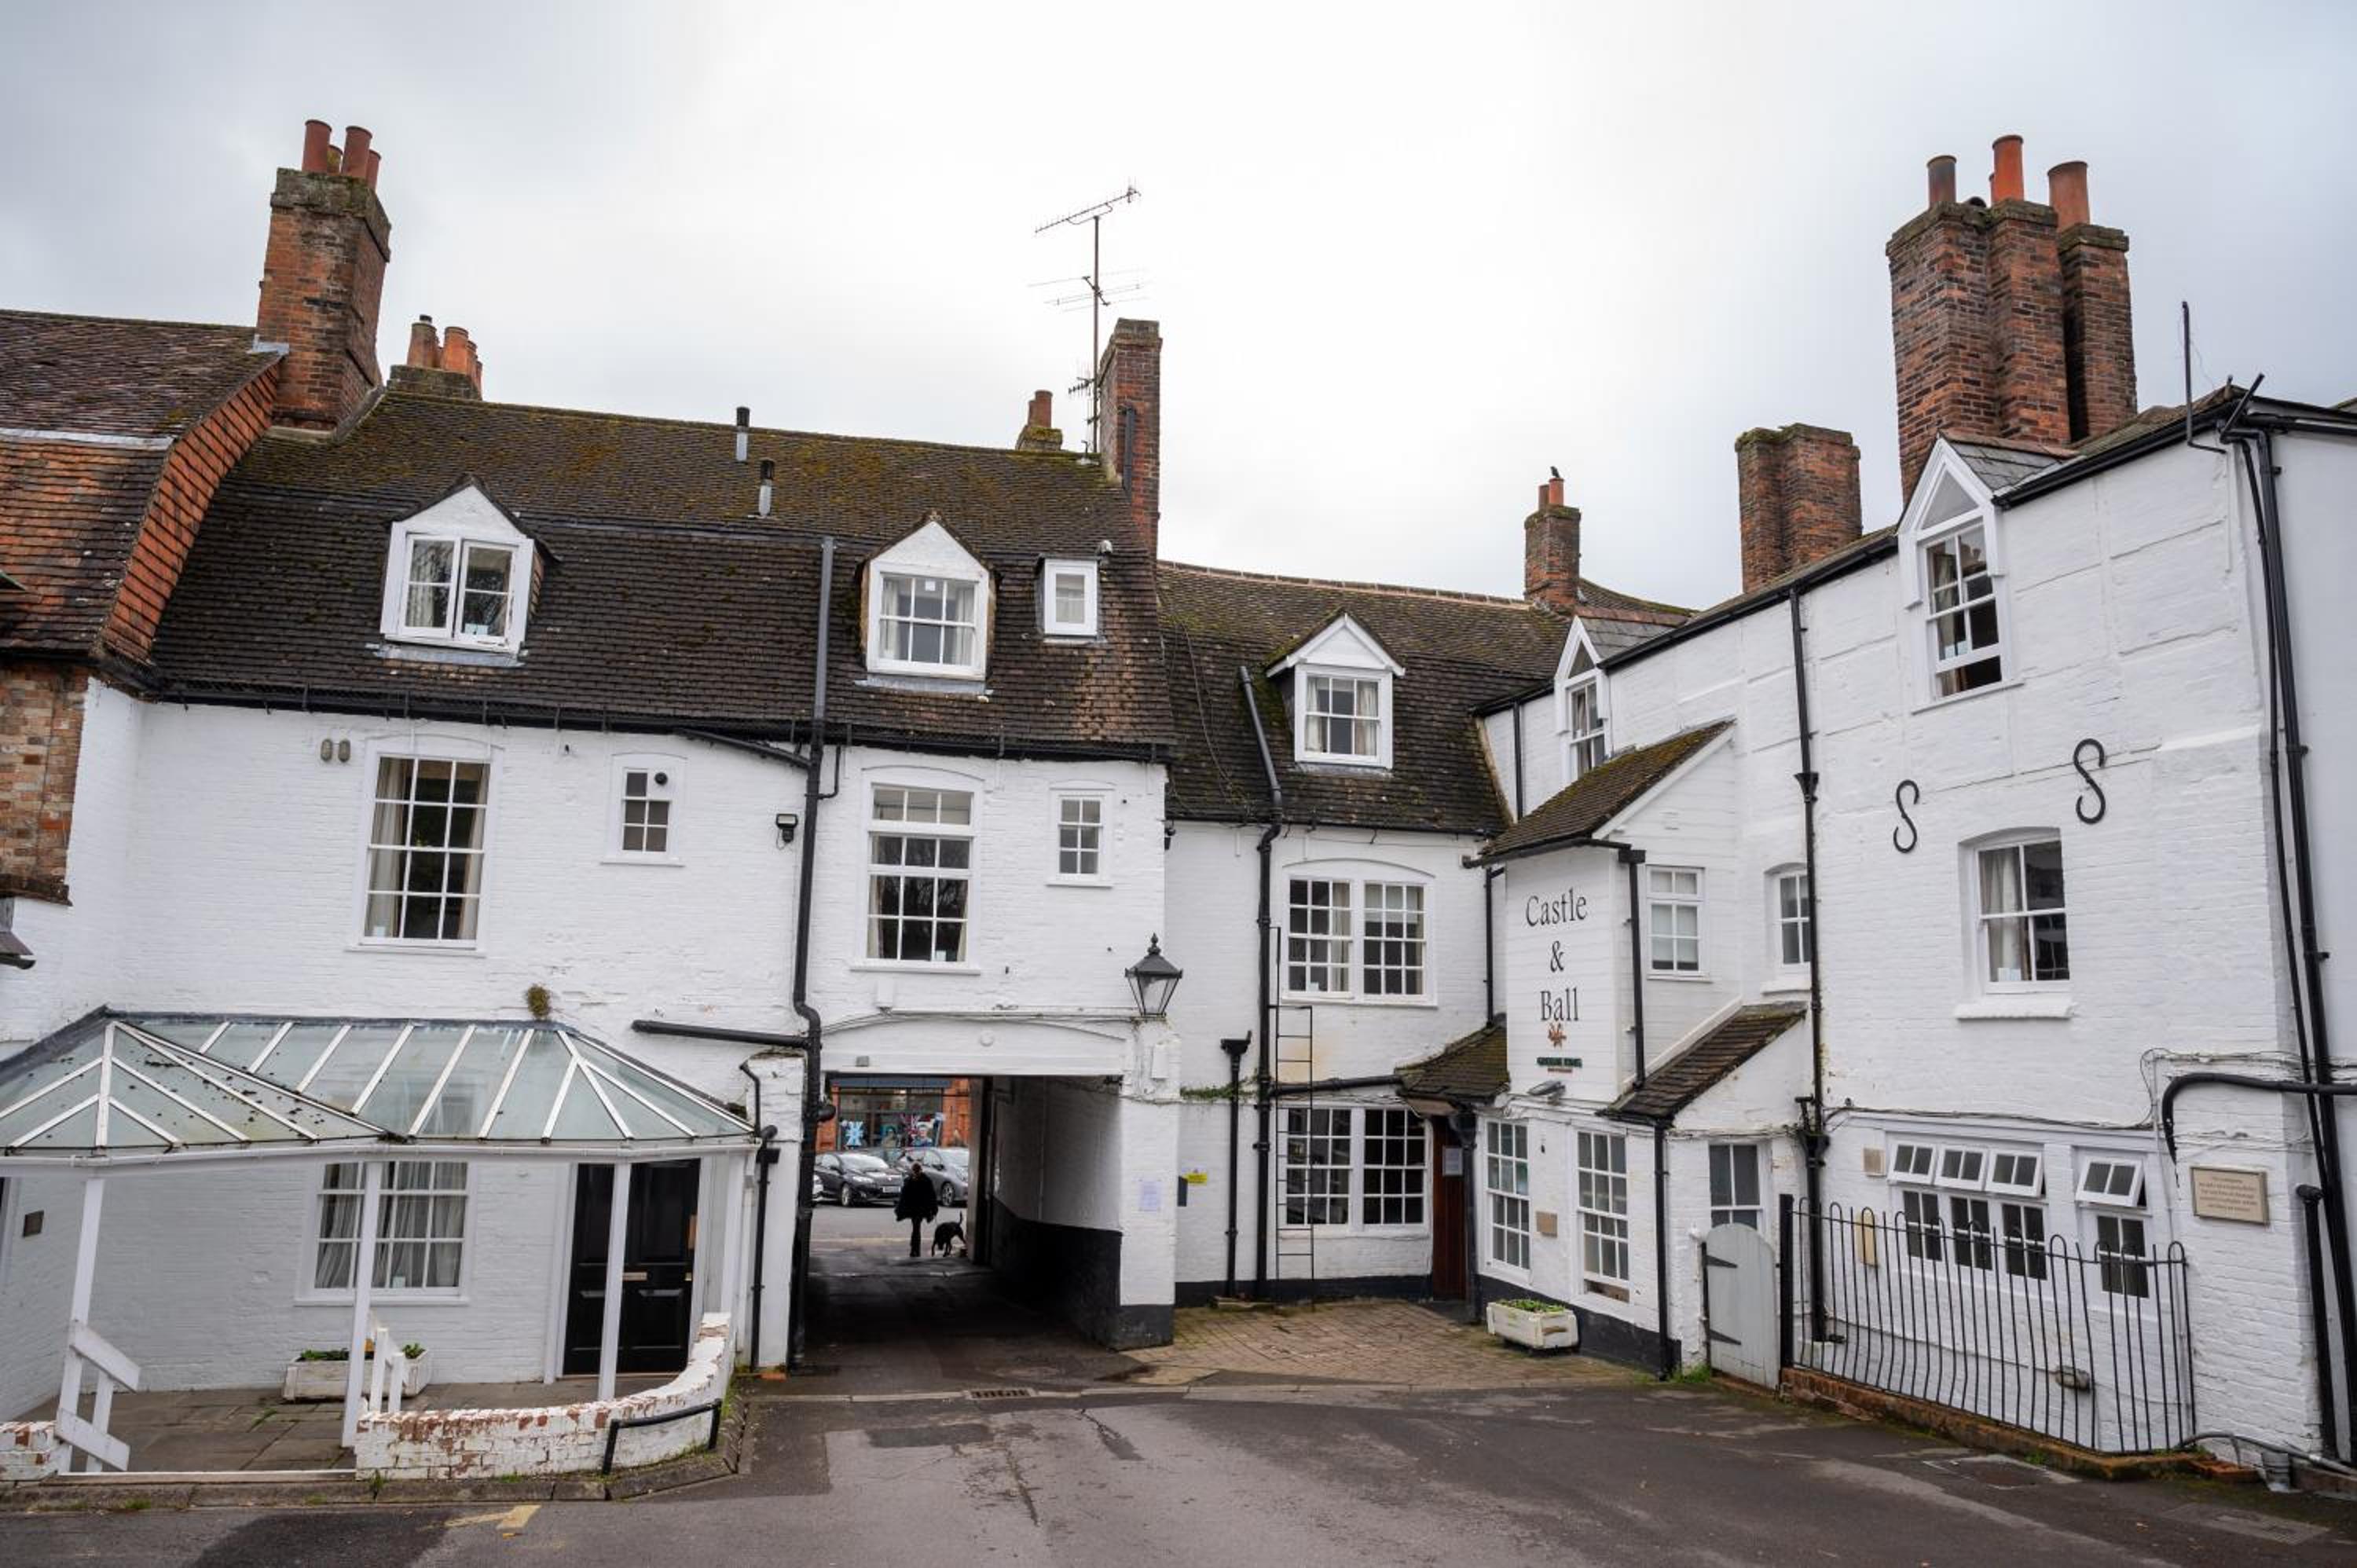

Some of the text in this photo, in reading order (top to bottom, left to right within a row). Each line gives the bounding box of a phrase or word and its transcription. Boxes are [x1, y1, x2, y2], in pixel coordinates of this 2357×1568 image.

[1526, 888, 1588, 927] Castle
[1550, 940, 1564, 973] &
[1540, 987, 1578, 1021] Ball
